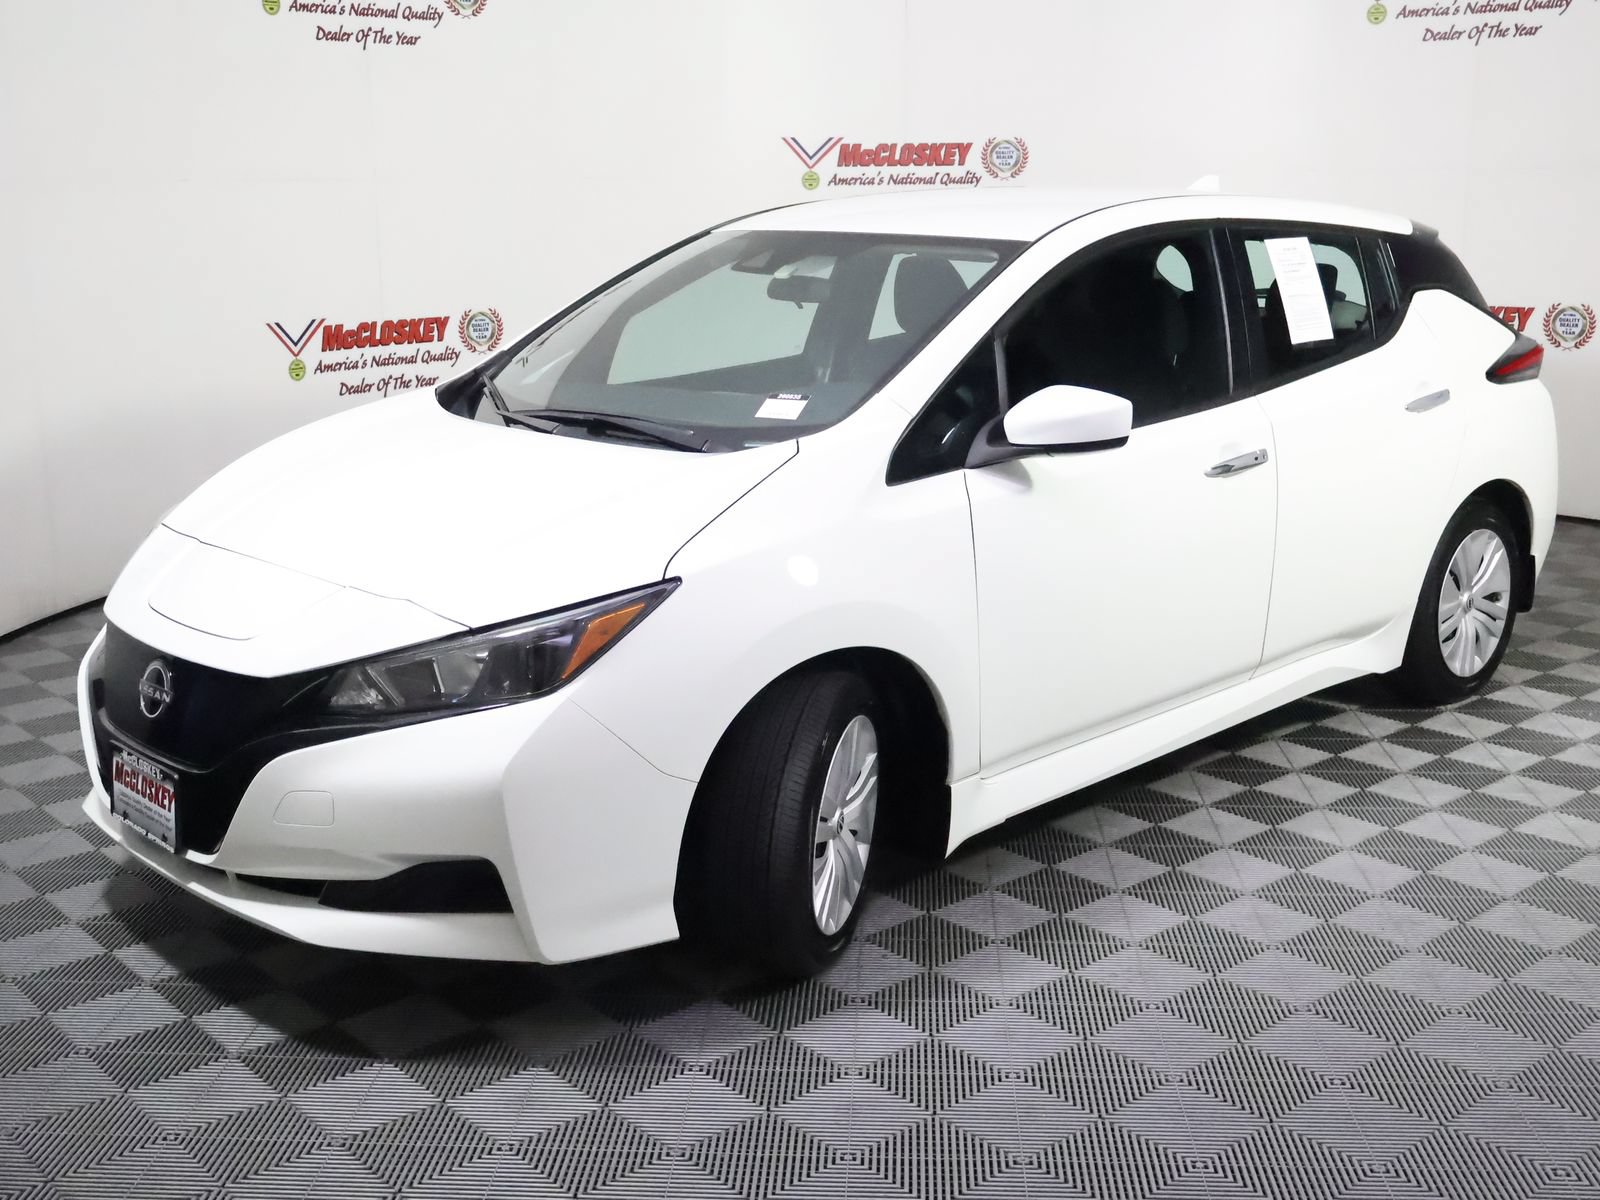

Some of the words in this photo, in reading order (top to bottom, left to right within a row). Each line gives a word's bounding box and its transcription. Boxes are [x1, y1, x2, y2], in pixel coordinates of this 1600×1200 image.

[288, 0, 346, 15] America's
[348, 3, 398, 19] National
[402, 6, 444, 28] Quality
[1396, 0, 1459, 19] America's
[1463, 0, 1520, 15] National
[316, 25, 353, 42] Dealer
[356, 27, 372, 50] Of
[372, 28, 392, 44] The
[396, 31, 420, 46] Year
[1422, 24, 1465, 42] Dealer
[1468, 22, 1488, 46] Of
[1487, 22, 1508, 38] The
[1513, 24, 1542, 37] Year
[837, 142, 974, 167] McCLOSKEY
[828, 170, 884, 186] America's
[888, 171, 939, 185] National
[940, 170, 982, 187] Quality
[322, 316, 450, 352] McCLOSKEY
[314, 353, 367, 374] America's
[370, 349, 417, 368] National
[422, 345, 461, 367] Quality
[339, 376, 375, 396] Dealer
[376, 375, 395, 398] Of
[393, 373, 415, 390] The
[415, 375, 439, 388] Year
[114, 760, 175, 813] McCLOSKEY
